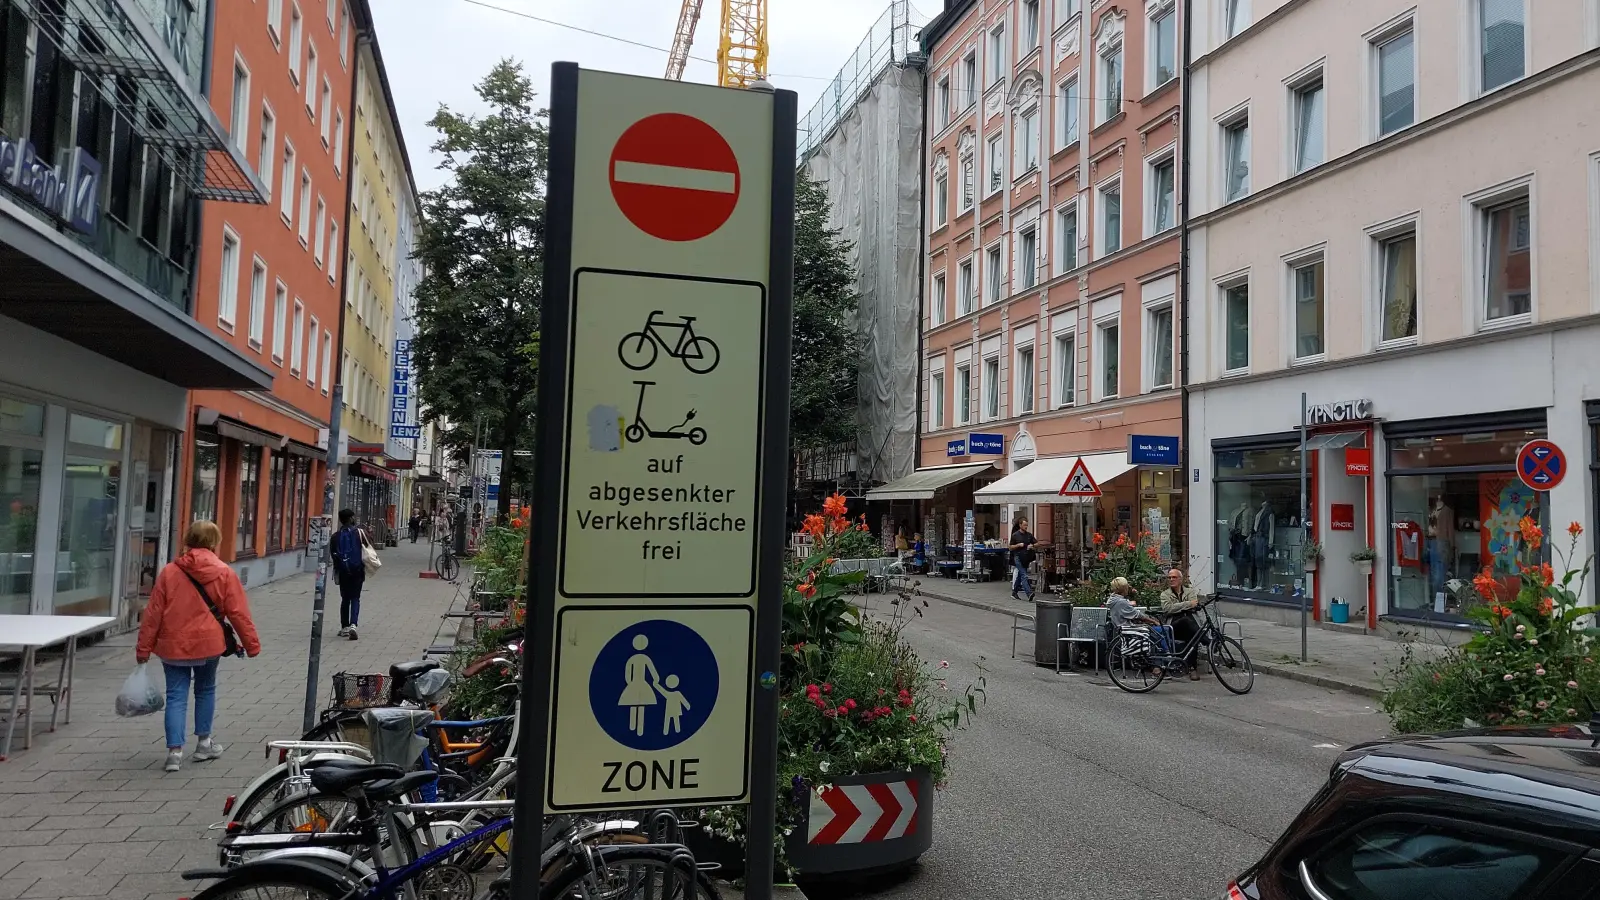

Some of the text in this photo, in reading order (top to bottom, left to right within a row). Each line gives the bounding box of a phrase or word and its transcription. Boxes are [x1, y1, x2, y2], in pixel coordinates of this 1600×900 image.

[394, 340, 408, 423] BETTEN
[1307, 399, 1373, 424] YPNOTIC
[393, 427, 420, 436] LENZ
[647, 455, 683, 473] auf
[589, 481, 735, 506] abgesenkter
[577, 510, 746, 531] Verkehrsfläche
[642, 540, 681, 559] frei
[602, 758, 699, 792] ZONE
